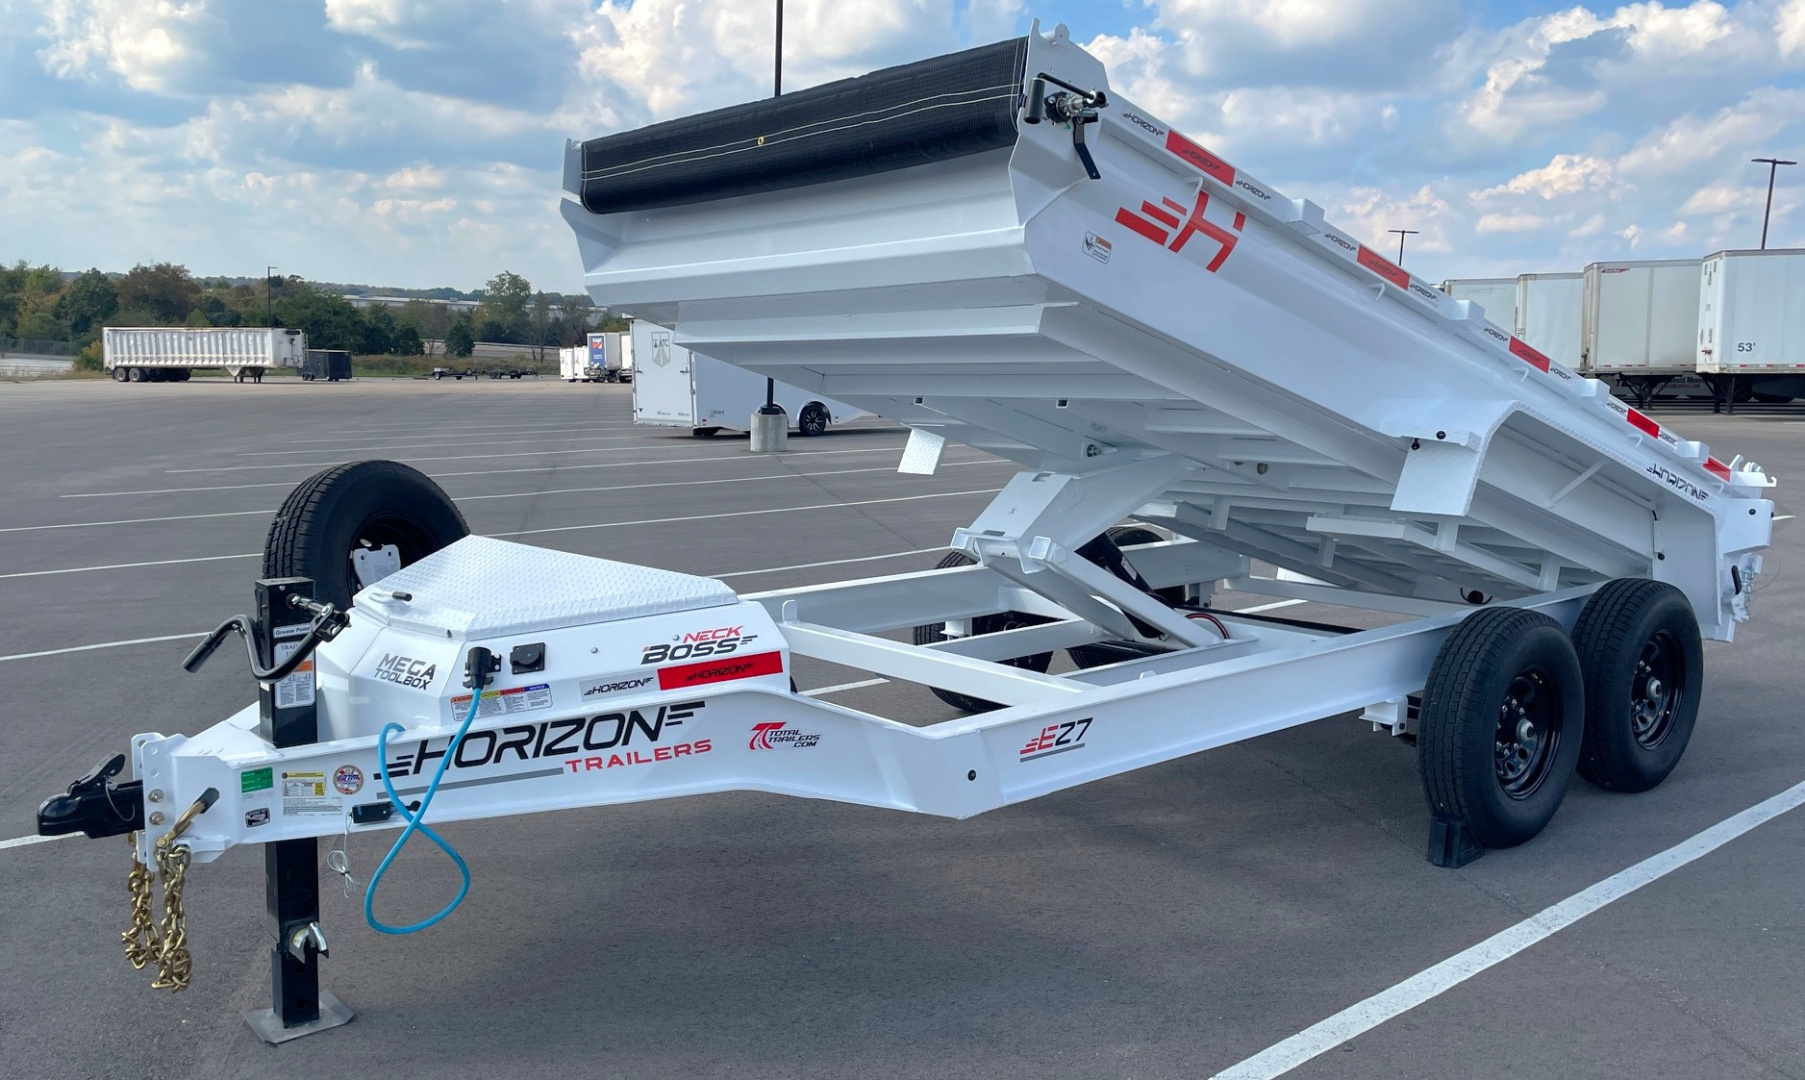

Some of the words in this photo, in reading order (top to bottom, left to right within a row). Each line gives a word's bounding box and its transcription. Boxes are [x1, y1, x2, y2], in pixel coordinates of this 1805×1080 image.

[1122, 112, 1165, 136] HORIZON
[1183, 148, 1221, 170] HORIZON
[1235, 179, 1272, 200] HORIZON
[1324, 233, 1356, 252] HORIZON
[1409, 283, 1437, 300] HORIZON
[1737, 342, 1756, 352] 53'
[682, 625, 745, 644] NECK
[281, 643, 299, 651] TRAI
[641, 635, 748, 664] BOSS
[378, 653, 437, 680] MEGA
[686, 663, 754, 681] HORIZON
[374, 668, 432, 690] TOOLBOX
[584, 677, 654, 696] HORIZON
[400, 704, 690, 777] HORIZON
[768, 735, 820, 743] TRAILERS
[769, 729, 801, 737] TOTAL
[565, 739, 712, 773] TRAILERS
